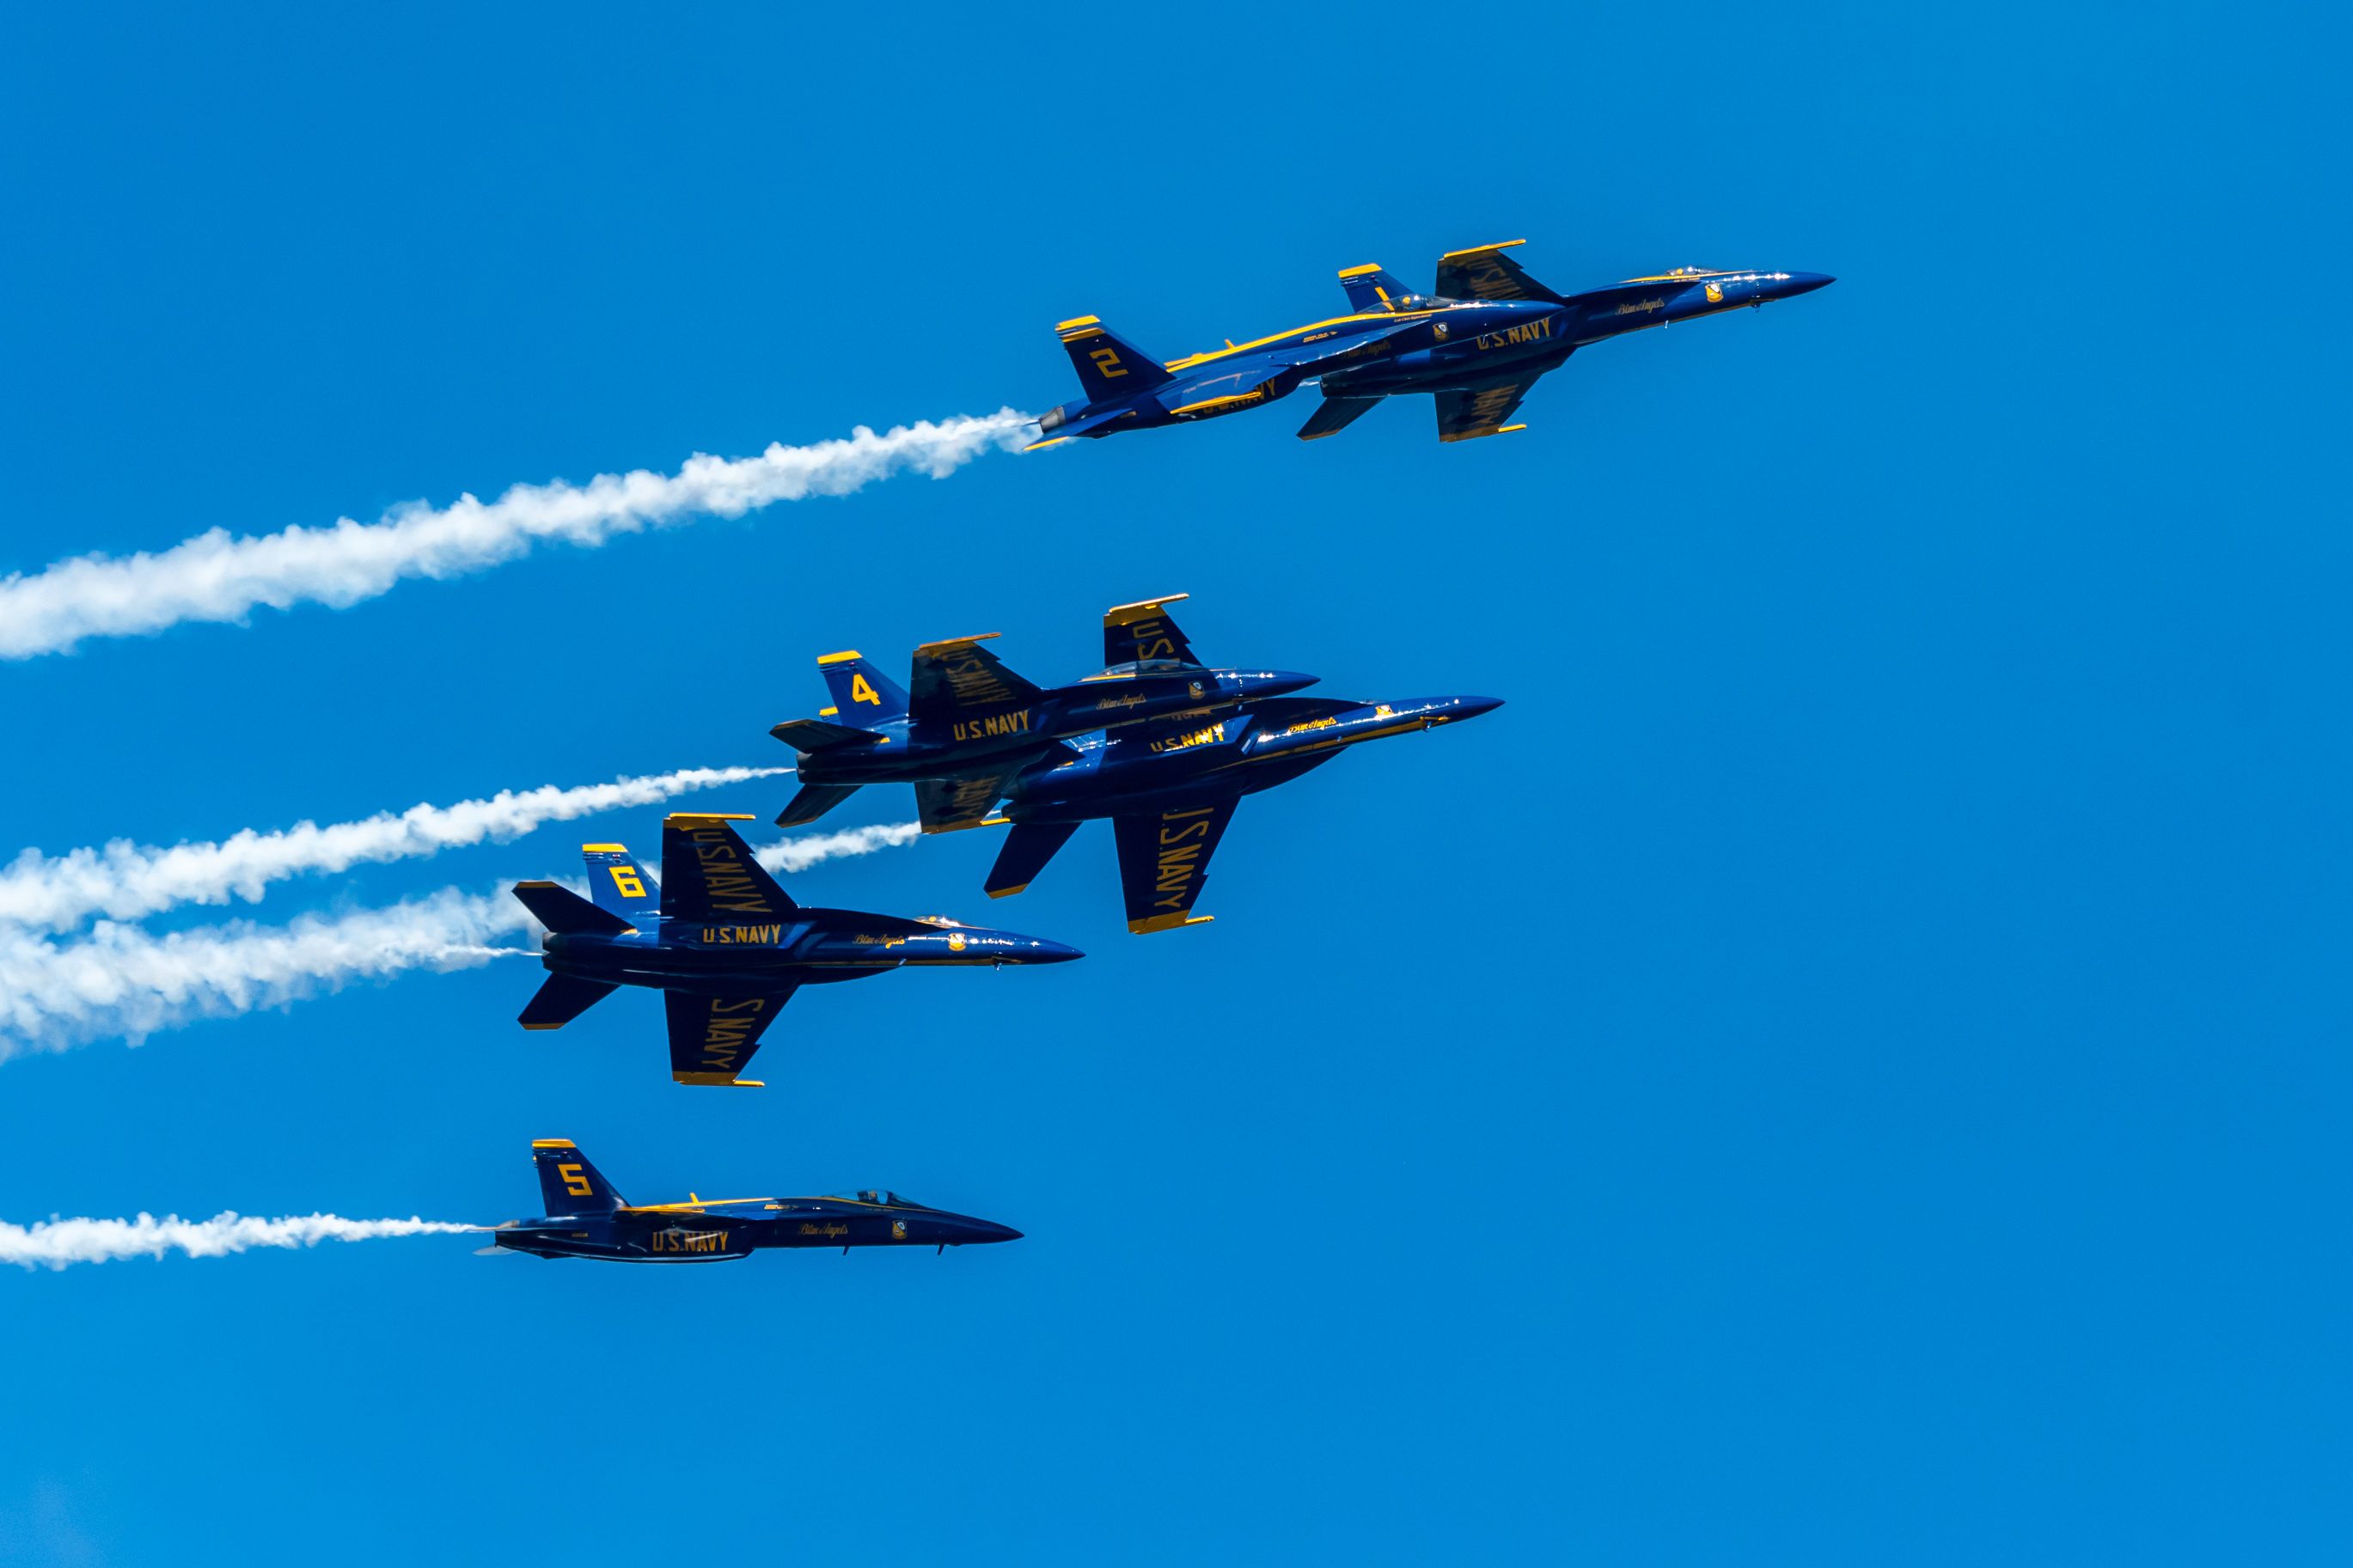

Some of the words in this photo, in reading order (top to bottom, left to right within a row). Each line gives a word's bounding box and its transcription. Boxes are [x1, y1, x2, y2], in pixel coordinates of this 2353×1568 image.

[1633, 296, 1665, 314] Angels
[1088, 347, 1128, 378] 2
[852, 673, 881, 705] 4
[1116, 693, 1146, 710] Angels
[608, 865, 647, 898] 6
[557, 1163, 593, 1196] 5
[798, 1223, 820, 1236] Blue
[818, 1221, 848, 1239] Angels
